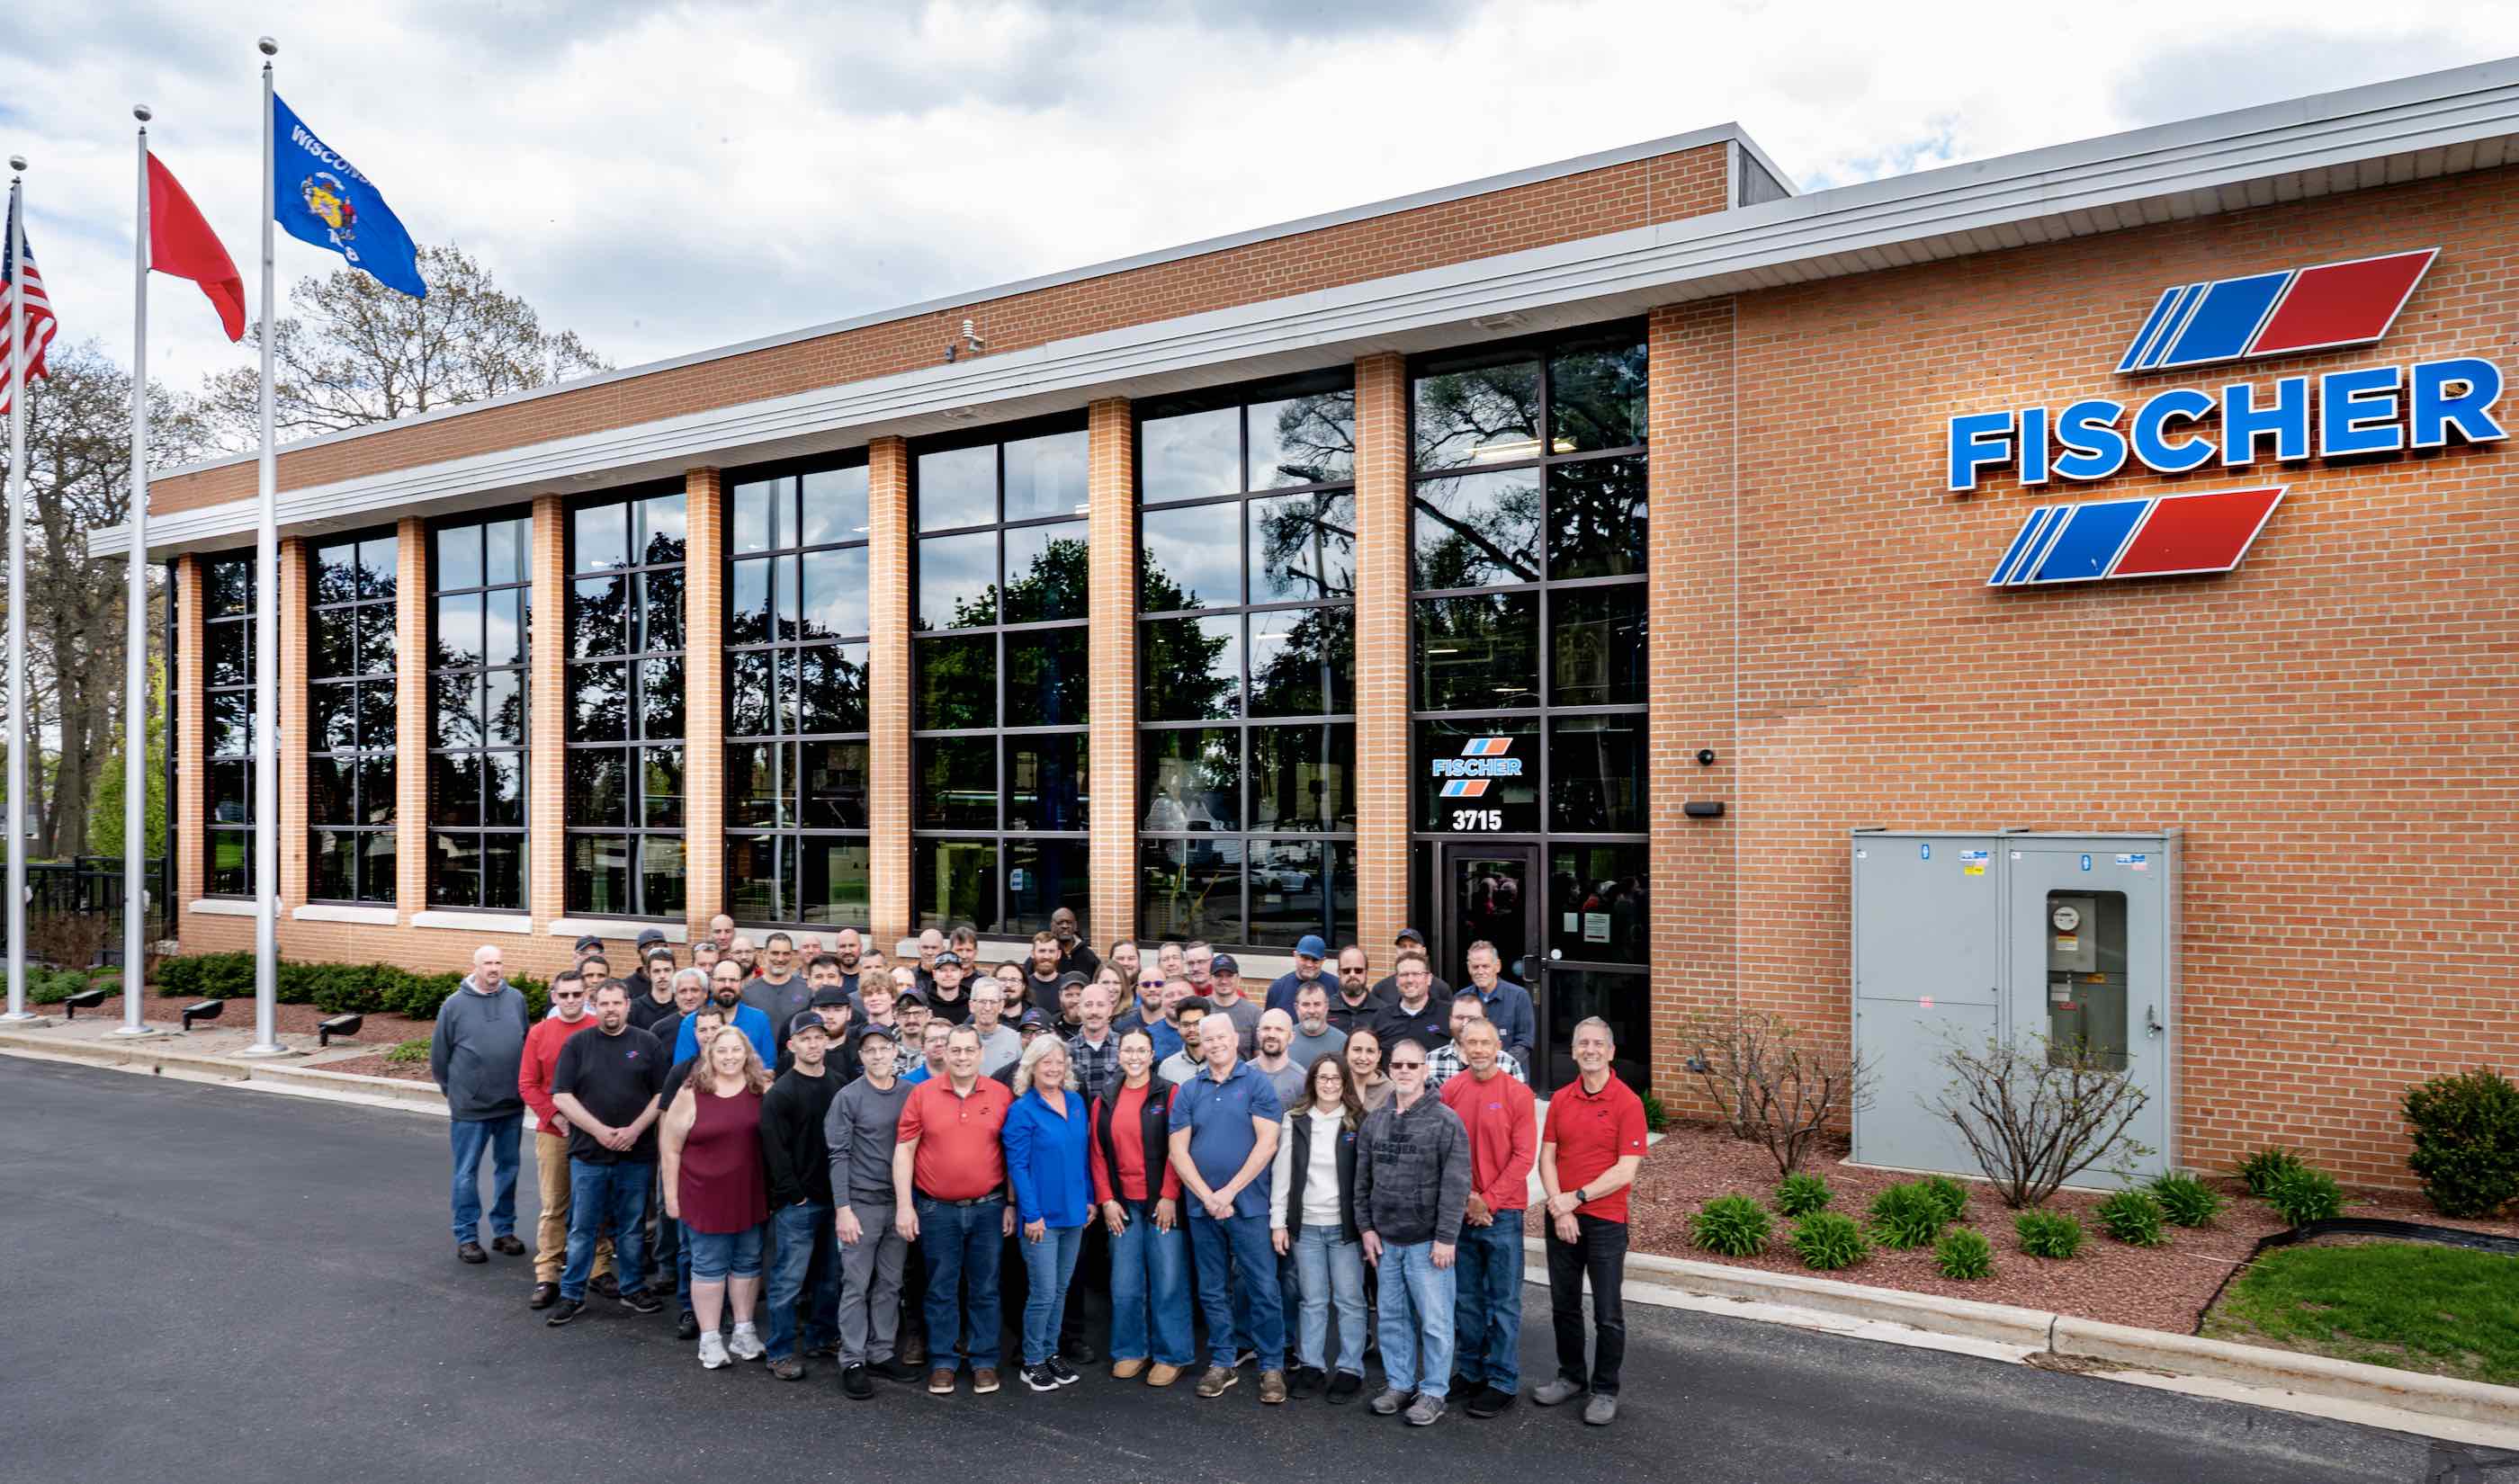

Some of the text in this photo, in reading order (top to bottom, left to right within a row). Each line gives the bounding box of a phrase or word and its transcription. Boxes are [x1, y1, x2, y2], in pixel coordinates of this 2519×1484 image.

[1949, 357, 2508, 490] FISCHER
[1431, 758, 1522, 776] FISCHER
[1452, 809, 1502, 830] 3715
